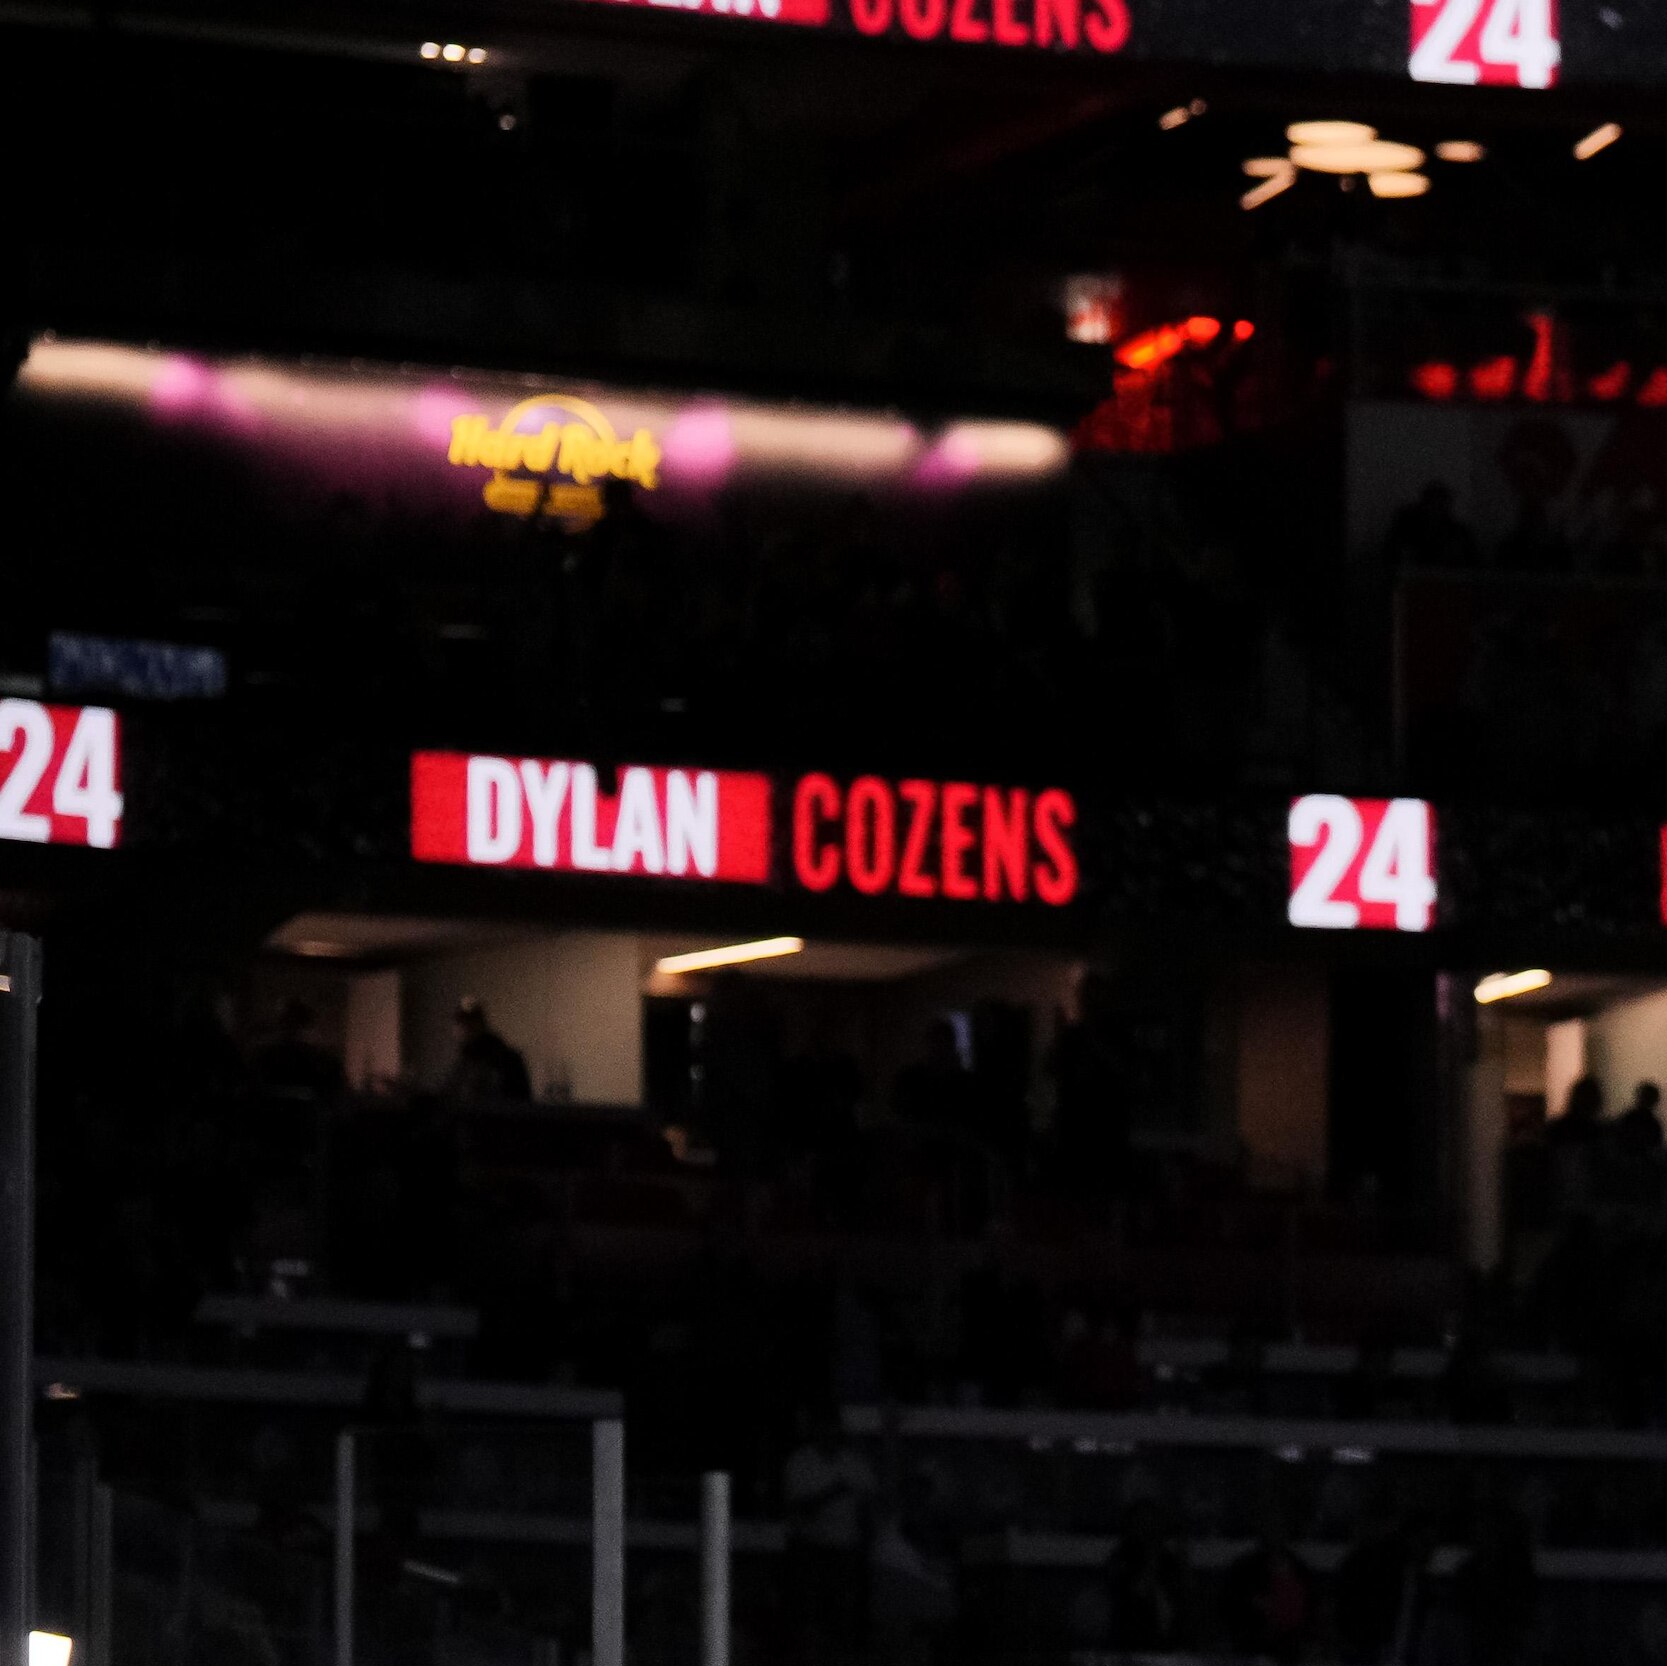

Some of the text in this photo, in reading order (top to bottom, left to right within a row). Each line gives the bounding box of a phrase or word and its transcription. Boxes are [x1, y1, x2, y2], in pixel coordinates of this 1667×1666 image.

[1408, 0, 1561, 89] 24
[0, 699, 123, 848] 24
[467, 756, 1078, 905] DYLAN COZENS
[1288, 794, 1437, 932] 24
